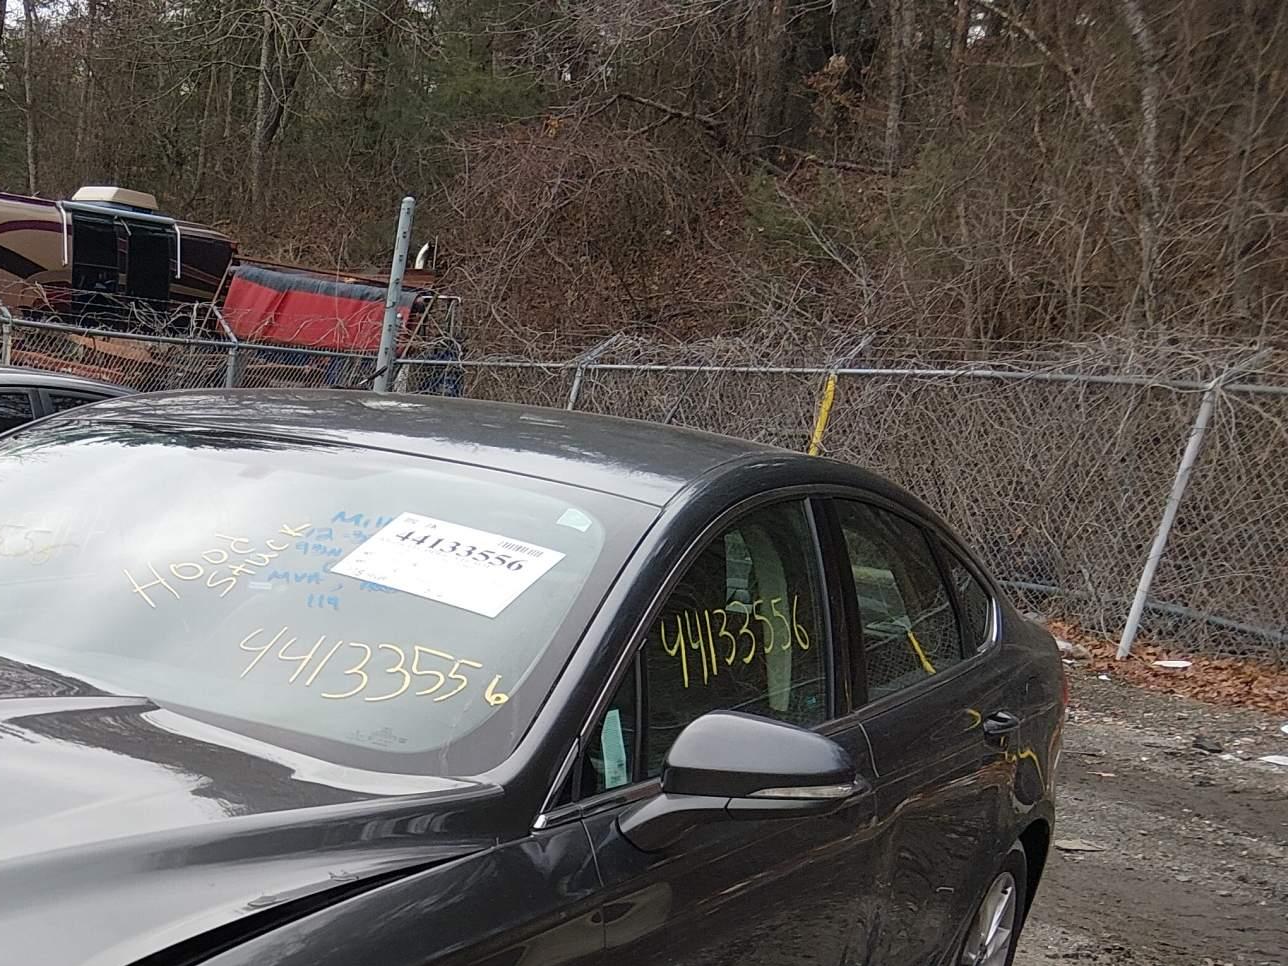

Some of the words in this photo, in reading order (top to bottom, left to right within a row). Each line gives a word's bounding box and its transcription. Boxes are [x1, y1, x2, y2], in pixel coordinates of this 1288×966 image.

[396, 530, 528, 572] 44133556
[239, 626, 510, 705] 44133556
[660, 594, 810, 688] 44133556
